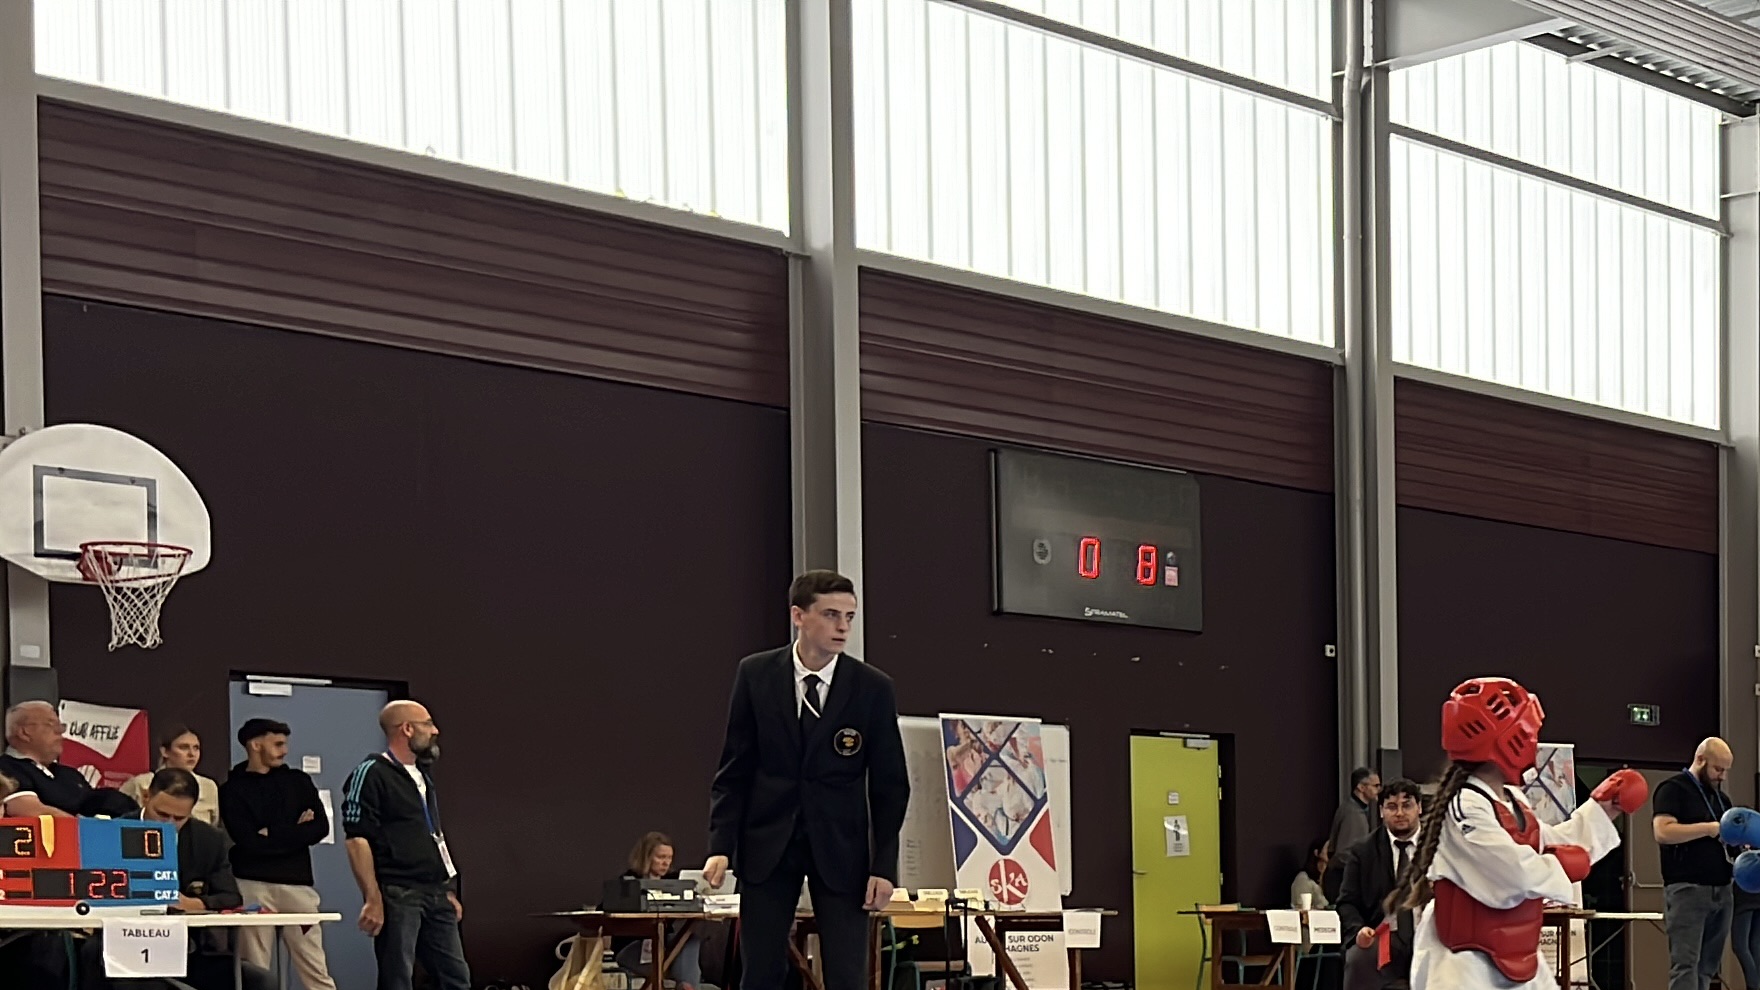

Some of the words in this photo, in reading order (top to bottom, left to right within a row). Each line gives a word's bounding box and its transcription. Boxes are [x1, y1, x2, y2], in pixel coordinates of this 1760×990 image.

[1079, 537, 1100, 579] 0
[1137, 545, 1157, 585] 8
[14, 827, 32, 856] 2
[144, 830, 161, 857] 0
[154, 870, 178, 881] CAT.1
[154, 890, 179, 900] CAT.2
[122, 928, 170, 938] TABLEAU
[1008, 935, 1025, 943] SUR
[1027, 934, 1054, 942] ODON
[141, 948, 149, 964] 1
